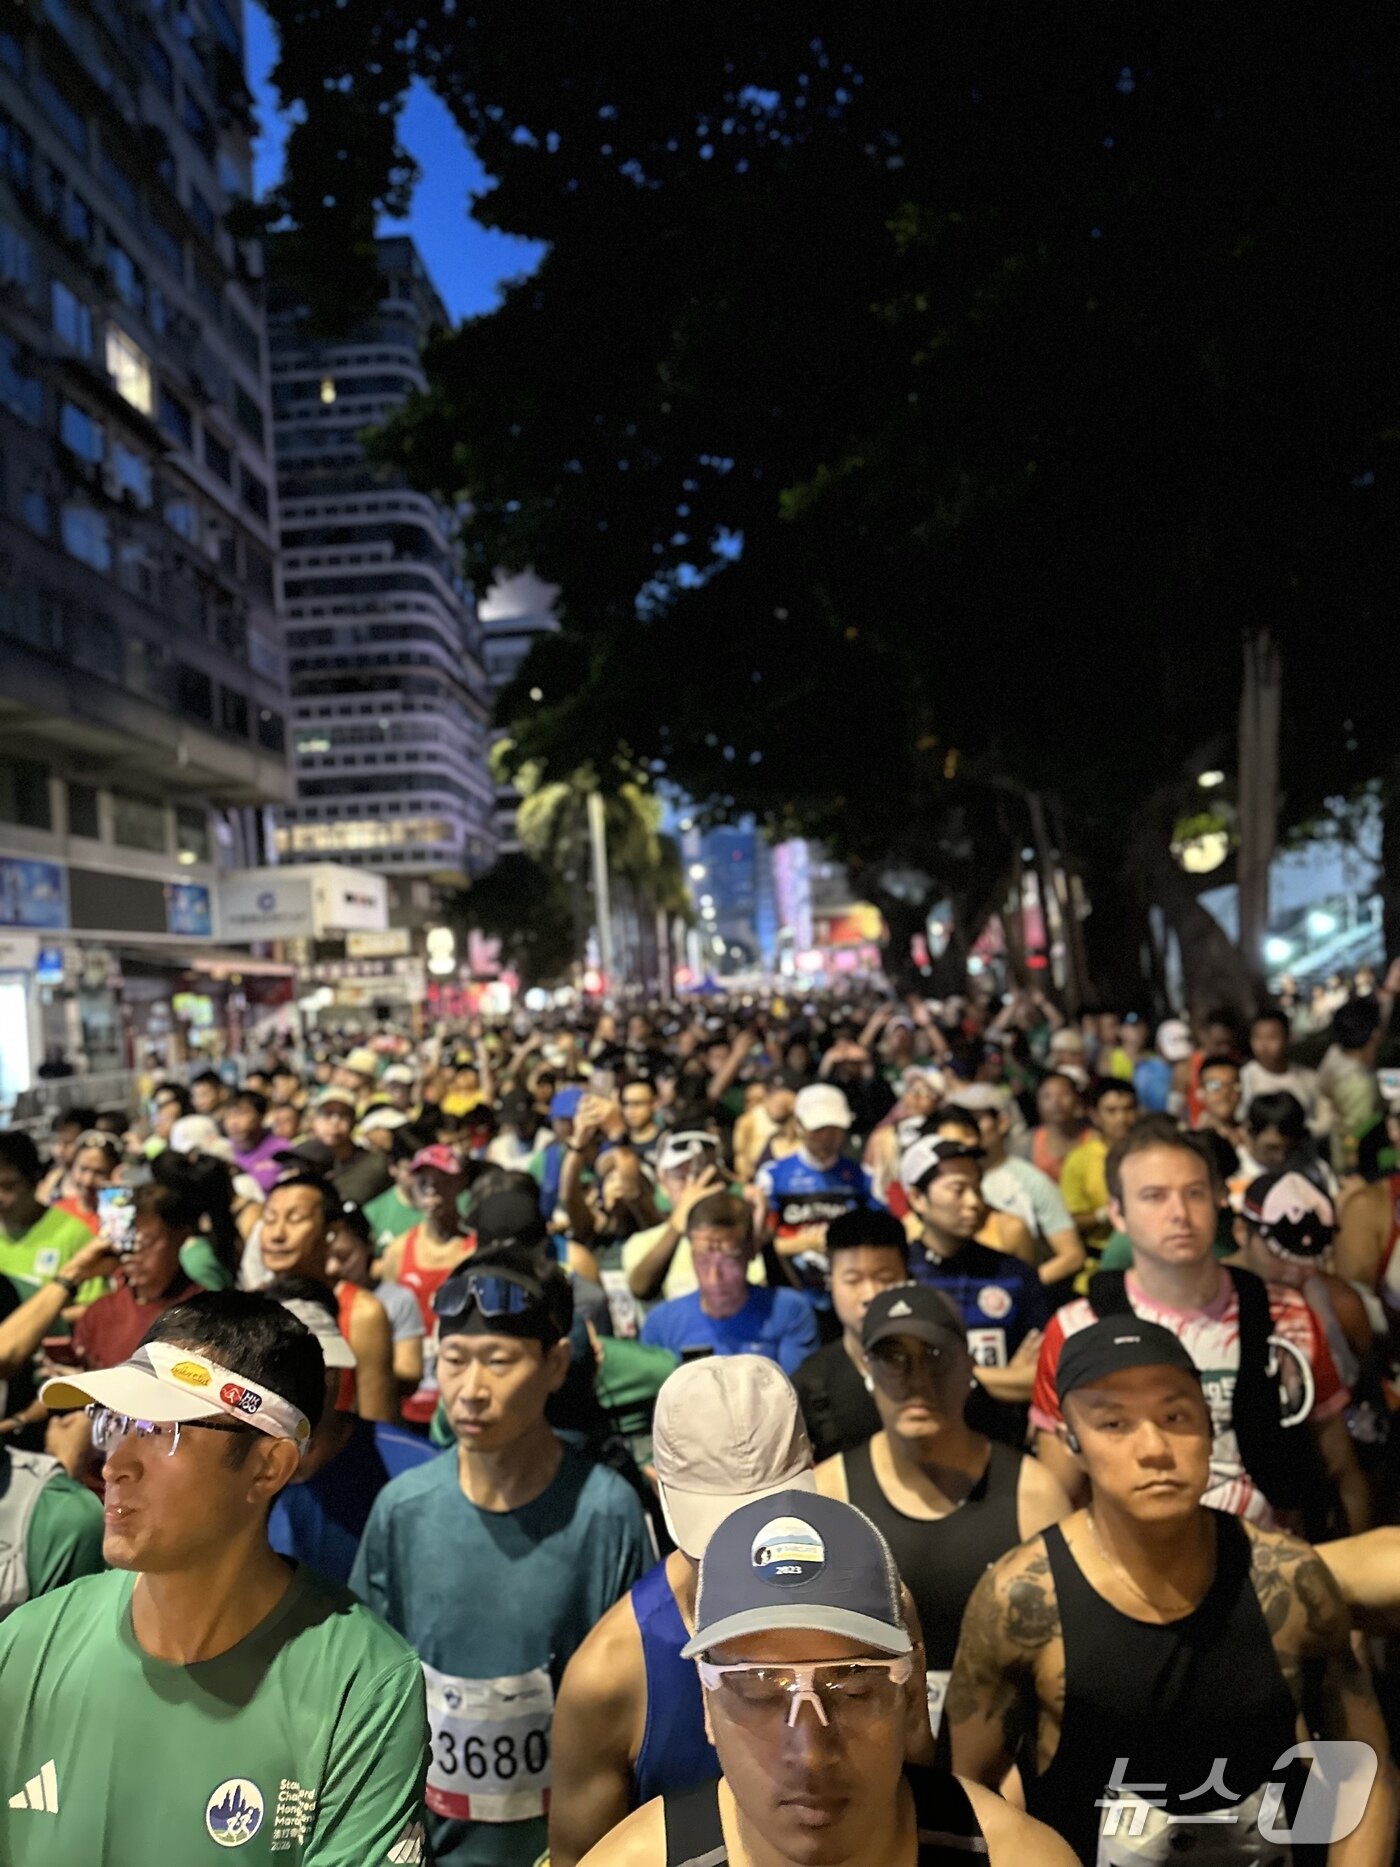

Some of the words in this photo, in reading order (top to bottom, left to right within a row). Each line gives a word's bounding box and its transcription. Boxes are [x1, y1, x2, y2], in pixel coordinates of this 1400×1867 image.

[244, 1391, 260, 1405] HK
[238, 1400, 257, 1413] 100
[775, 1565, 803, 1575] 2023
[438, 1728, 549, 1780] 3680
